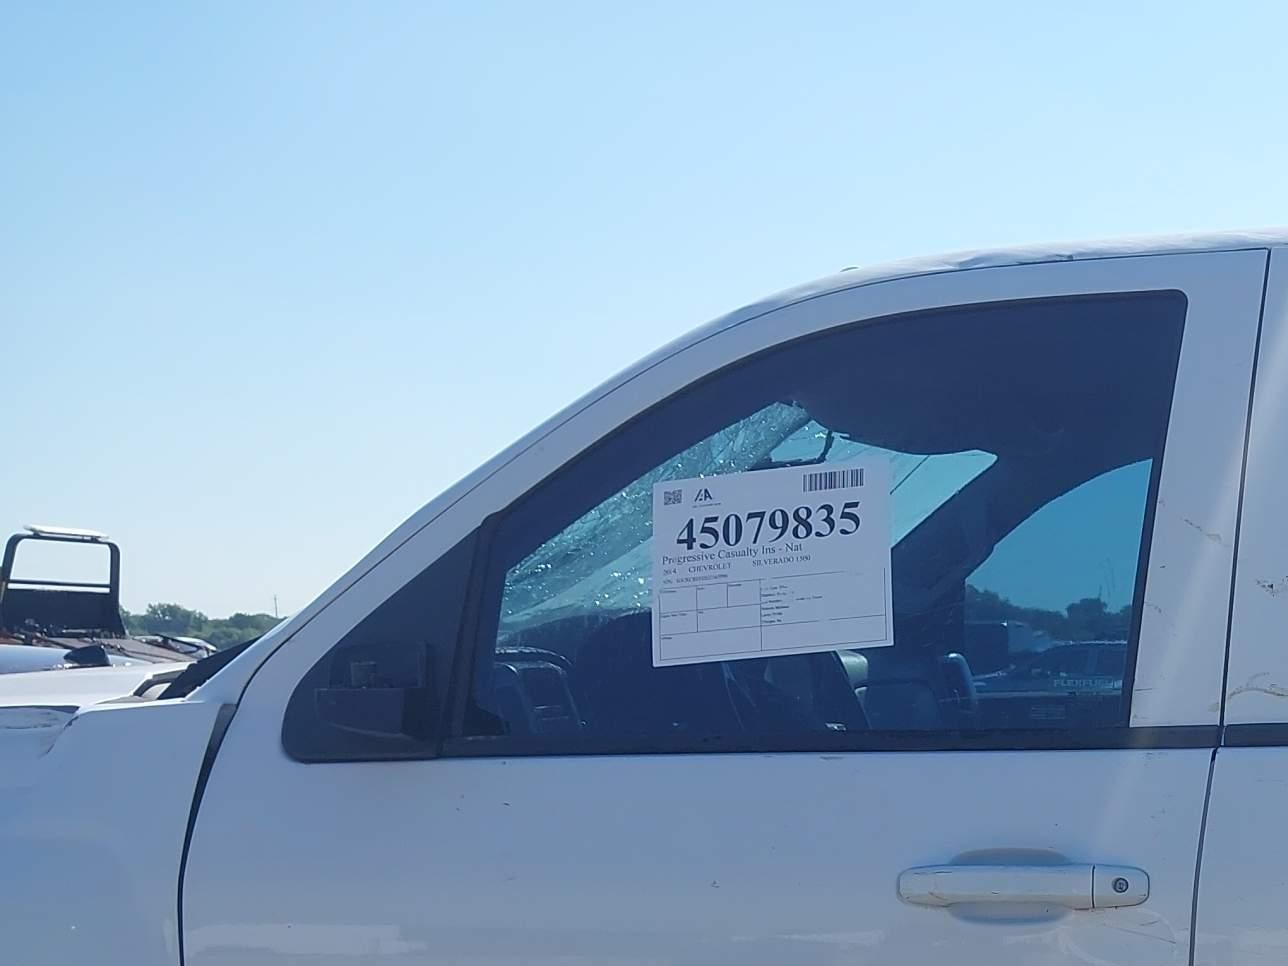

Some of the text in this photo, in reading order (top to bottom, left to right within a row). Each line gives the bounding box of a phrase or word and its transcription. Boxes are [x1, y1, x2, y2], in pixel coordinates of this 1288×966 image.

[676, 501, 860, 550] 45079835
[662, 551, 715, 565] Progressive
[718, 546, 758, 559] Casualty
[762, 545, 776, 555] Ins
[785, 543, 802, 552] Nat
[688, 562, 731, 573] CHEVROLET
[752, 557, 794, 567] SILVERADO
